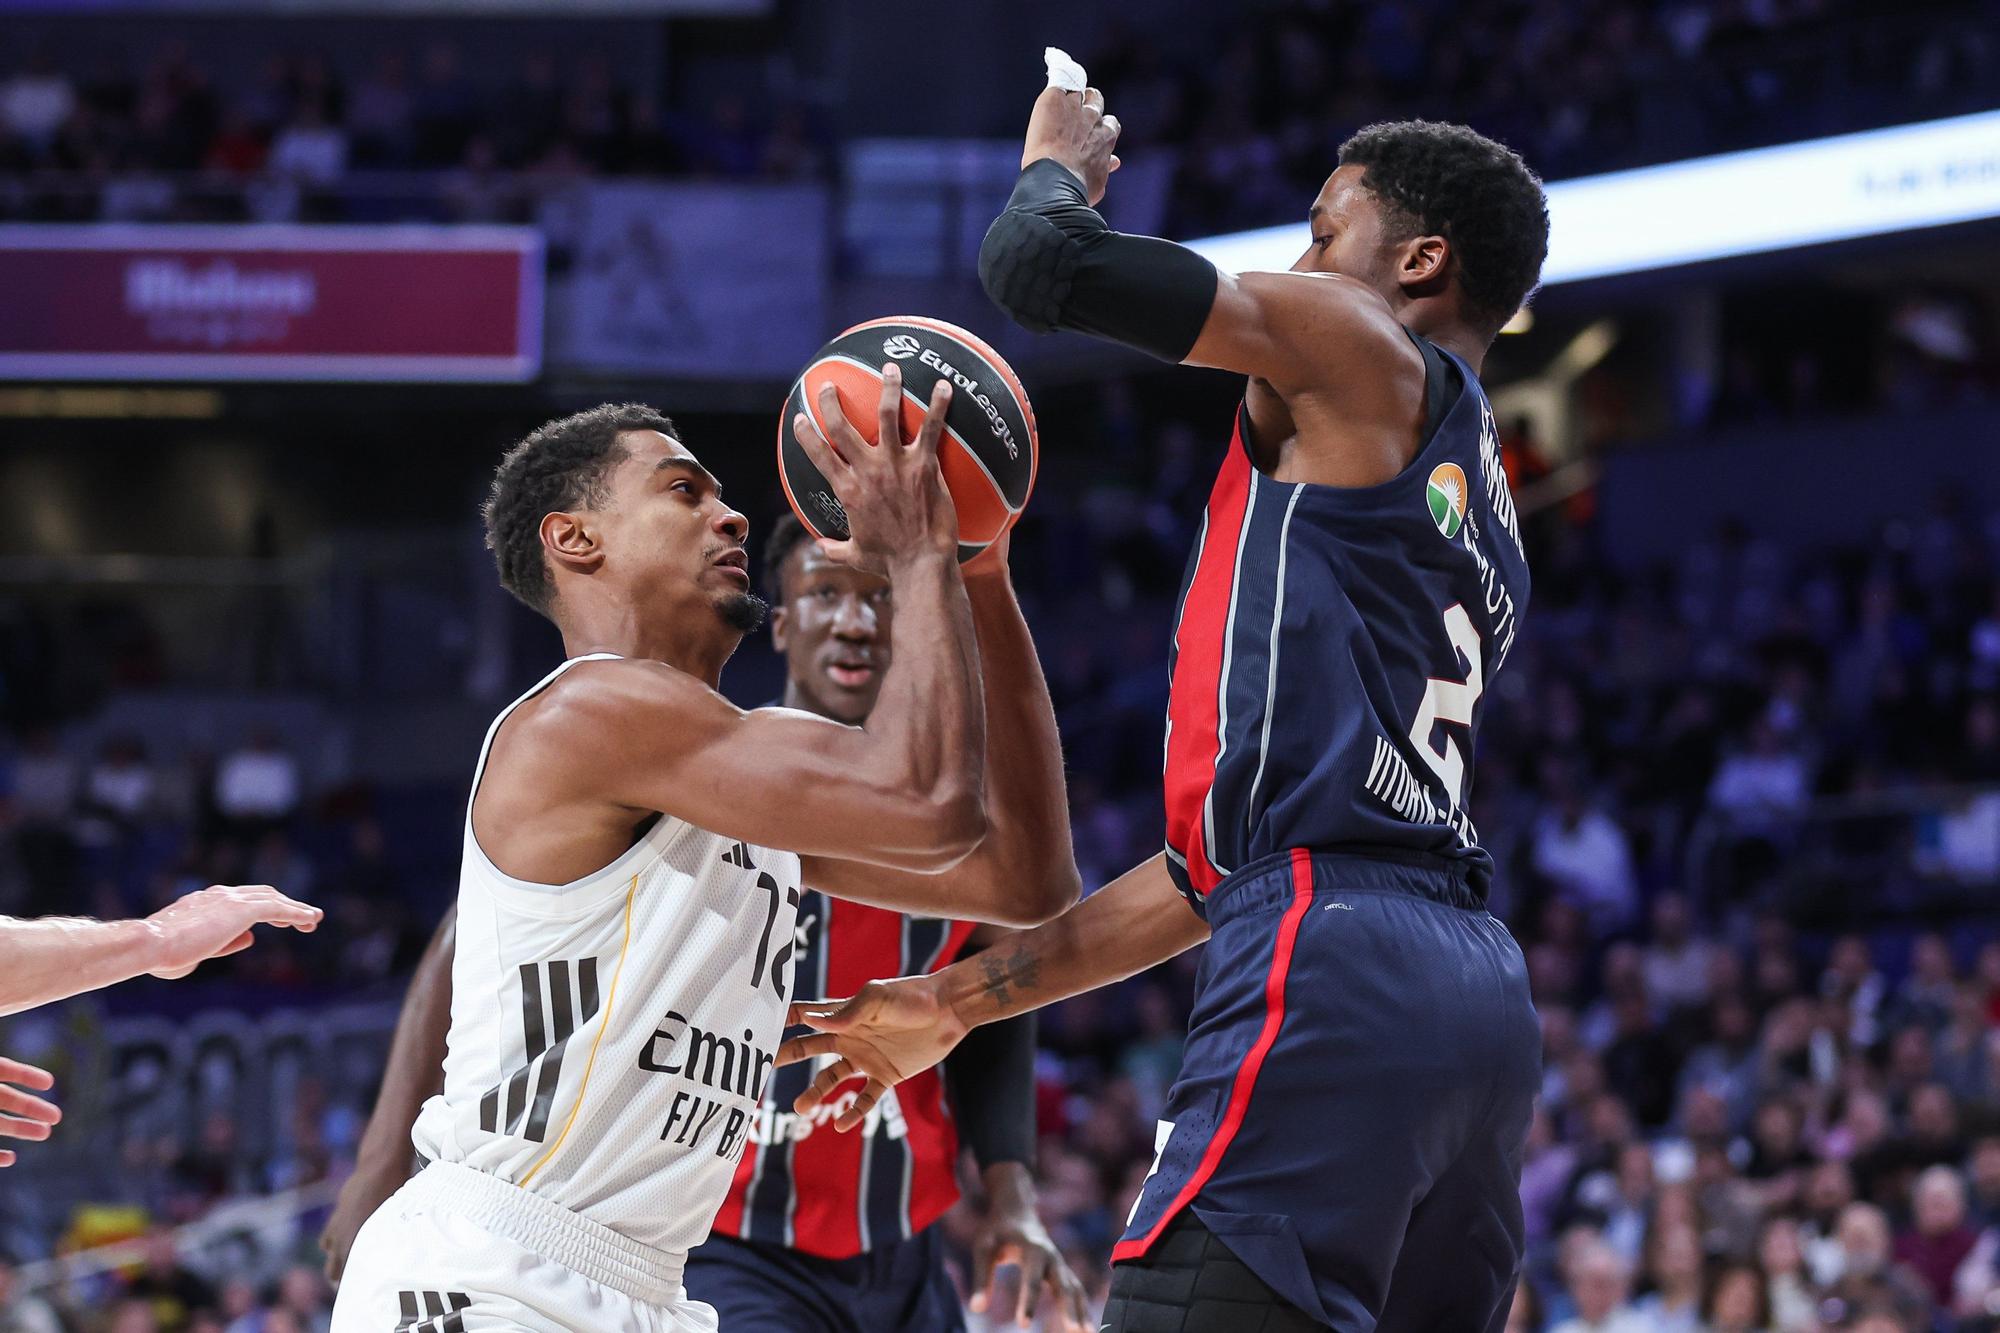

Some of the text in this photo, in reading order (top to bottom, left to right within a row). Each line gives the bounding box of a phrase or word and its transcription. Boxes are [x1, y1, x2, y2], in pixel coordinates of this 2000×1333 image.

[919, 348, 1018, 461] EuroLeague
[1408, 601, 1484, 809] 2
[659, 1091, 723, 1148] FLY
